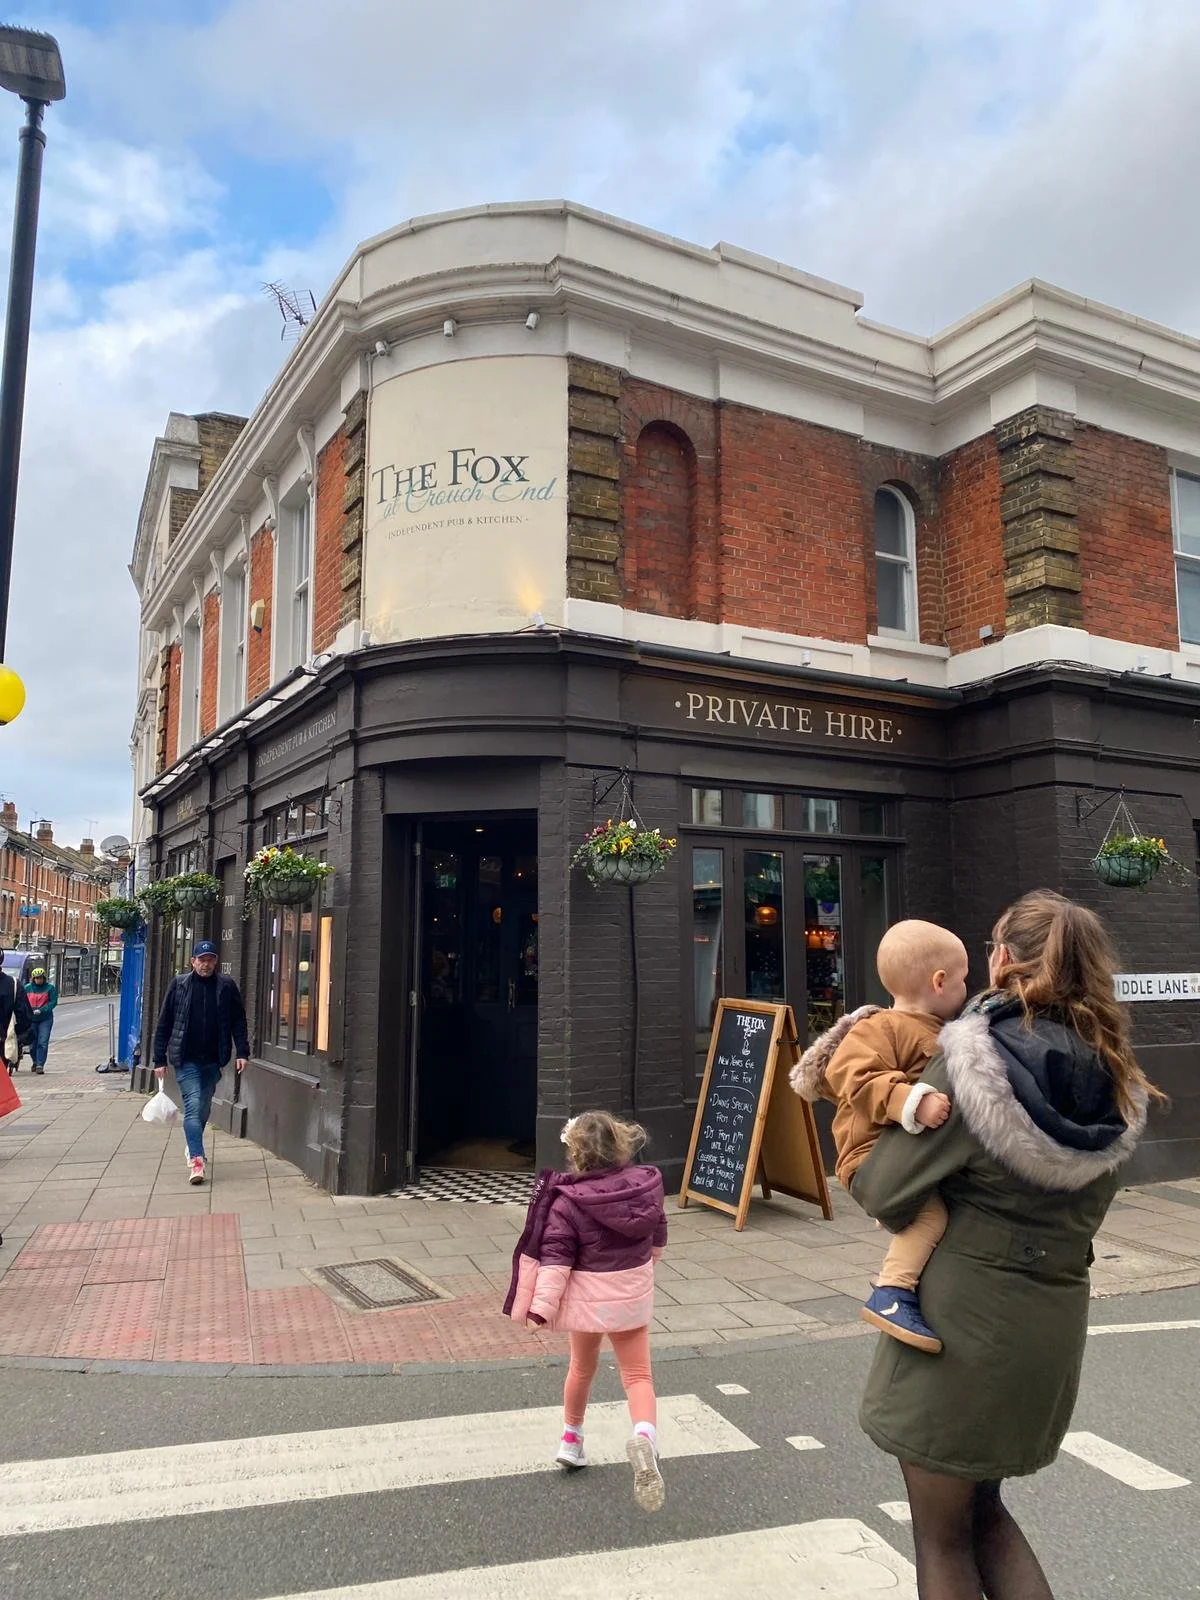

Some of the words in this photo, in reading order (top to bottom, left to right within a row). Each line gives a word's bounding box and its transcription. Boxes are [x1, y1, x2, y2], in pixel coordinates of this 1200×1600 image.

[383, 494, 400, 519] at
[404, 476, 483, 513] Crouch
[491, 469, 559, 503] End
[388, 520, 444, 540] INDEPENDENT
[446, 517, 465, 528] PUB
[467, 517, 473, 525] &
[476, 515, 523, 525] KITCHEN
[308, 711, 337, 740] KITCHEN
[686, 692, 813, 734] PRIVATE
[824, 710, 894, 744] HIRE
[1117, 981, 1153, 995] IDDLE
[1158, 979, 1189, 994] LANE
[736, 1014, 751, 1028] THE
[751, 1017, 766, 1030] FOX
